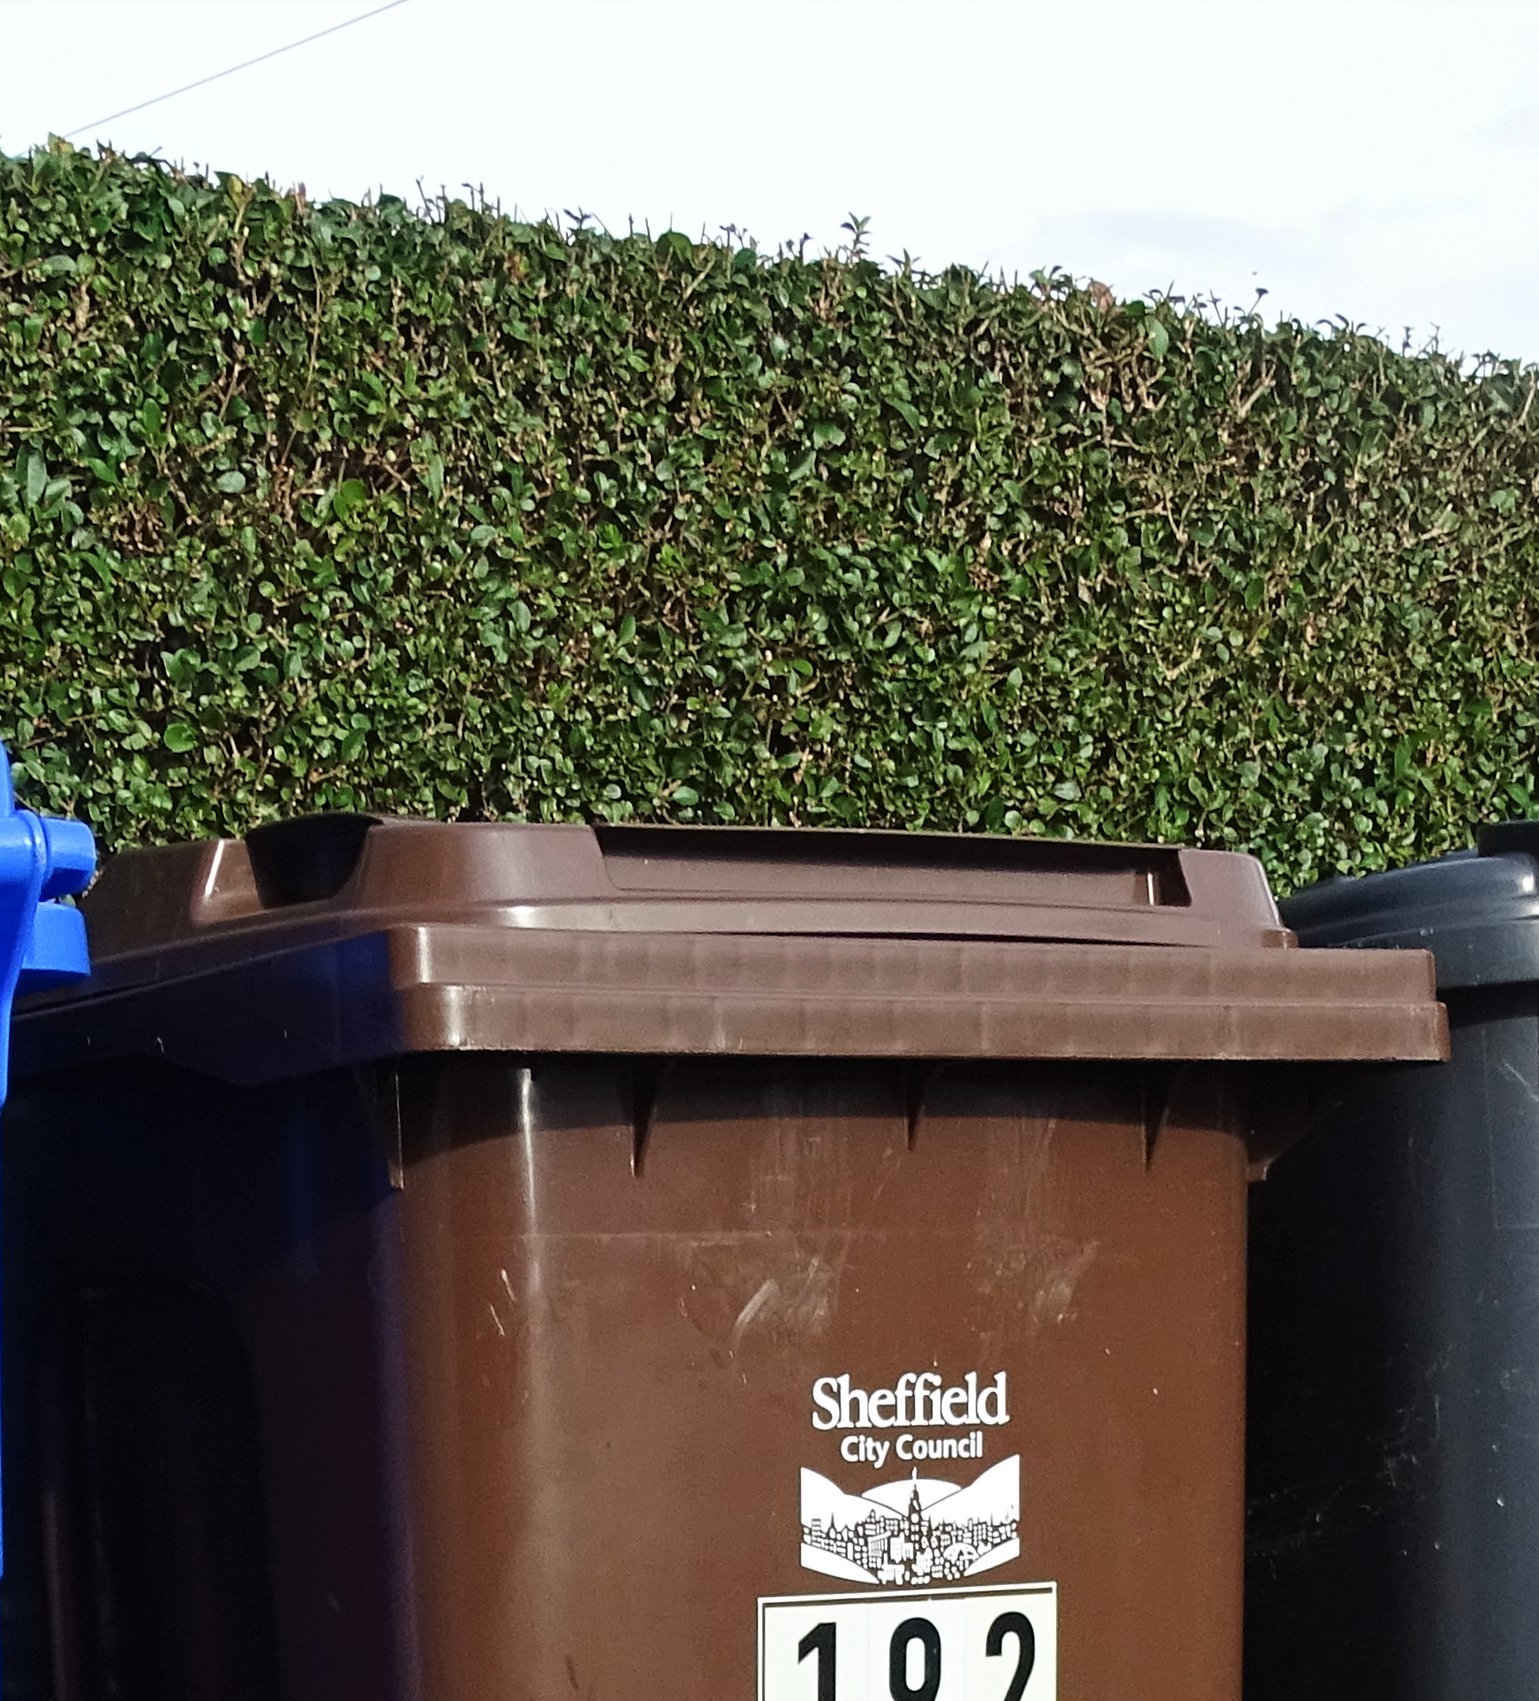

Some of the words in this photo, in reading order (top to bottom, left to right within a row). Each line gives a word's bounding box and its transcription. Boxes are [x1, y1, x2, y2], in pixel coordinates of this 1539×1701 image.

[812, 1371, 1011, 1430] Sheffield
[840, 1434, 890, 1469] City
[895, 1430, 983, 1461] Council
